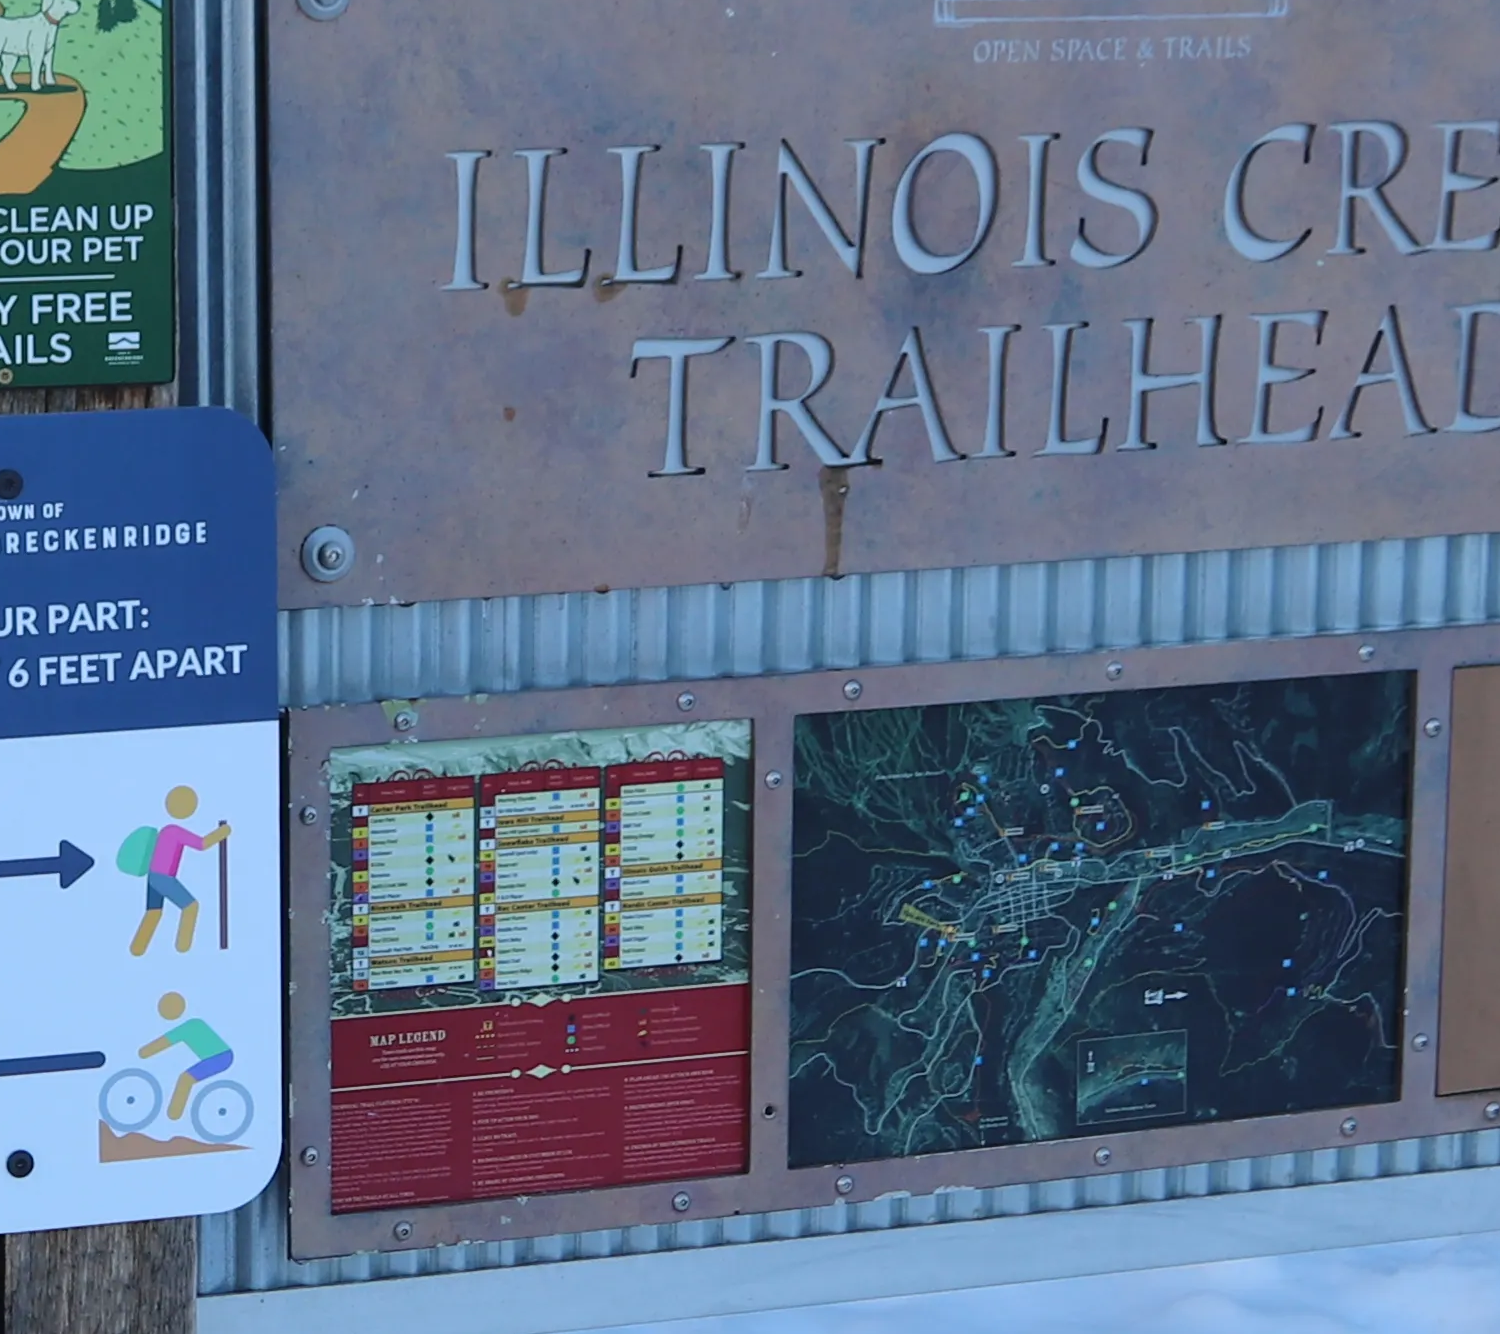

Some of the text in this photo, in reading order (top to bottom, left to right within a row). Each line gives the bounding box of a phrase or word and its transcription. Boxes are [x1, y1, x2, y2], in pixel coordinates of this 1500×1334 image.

[973, 35, 1251, 63] OPEN SPACE & TRAILS
[109, 204, 153, 232] UP
[439, 127, 1160, 290] ILLINOIS
[83, 236, 144, 263] PET
[31, 292, 133, 325] FREE
[42, 502, 65, 519] OF
[48, 599, 150, 635] PART:
[8, 658, 28, 689] 6
[38, 651, 122, 686] FEET
[129, 644, 248, 680] APART
[370, 1029, 447, 1047] MAP LEGEND
